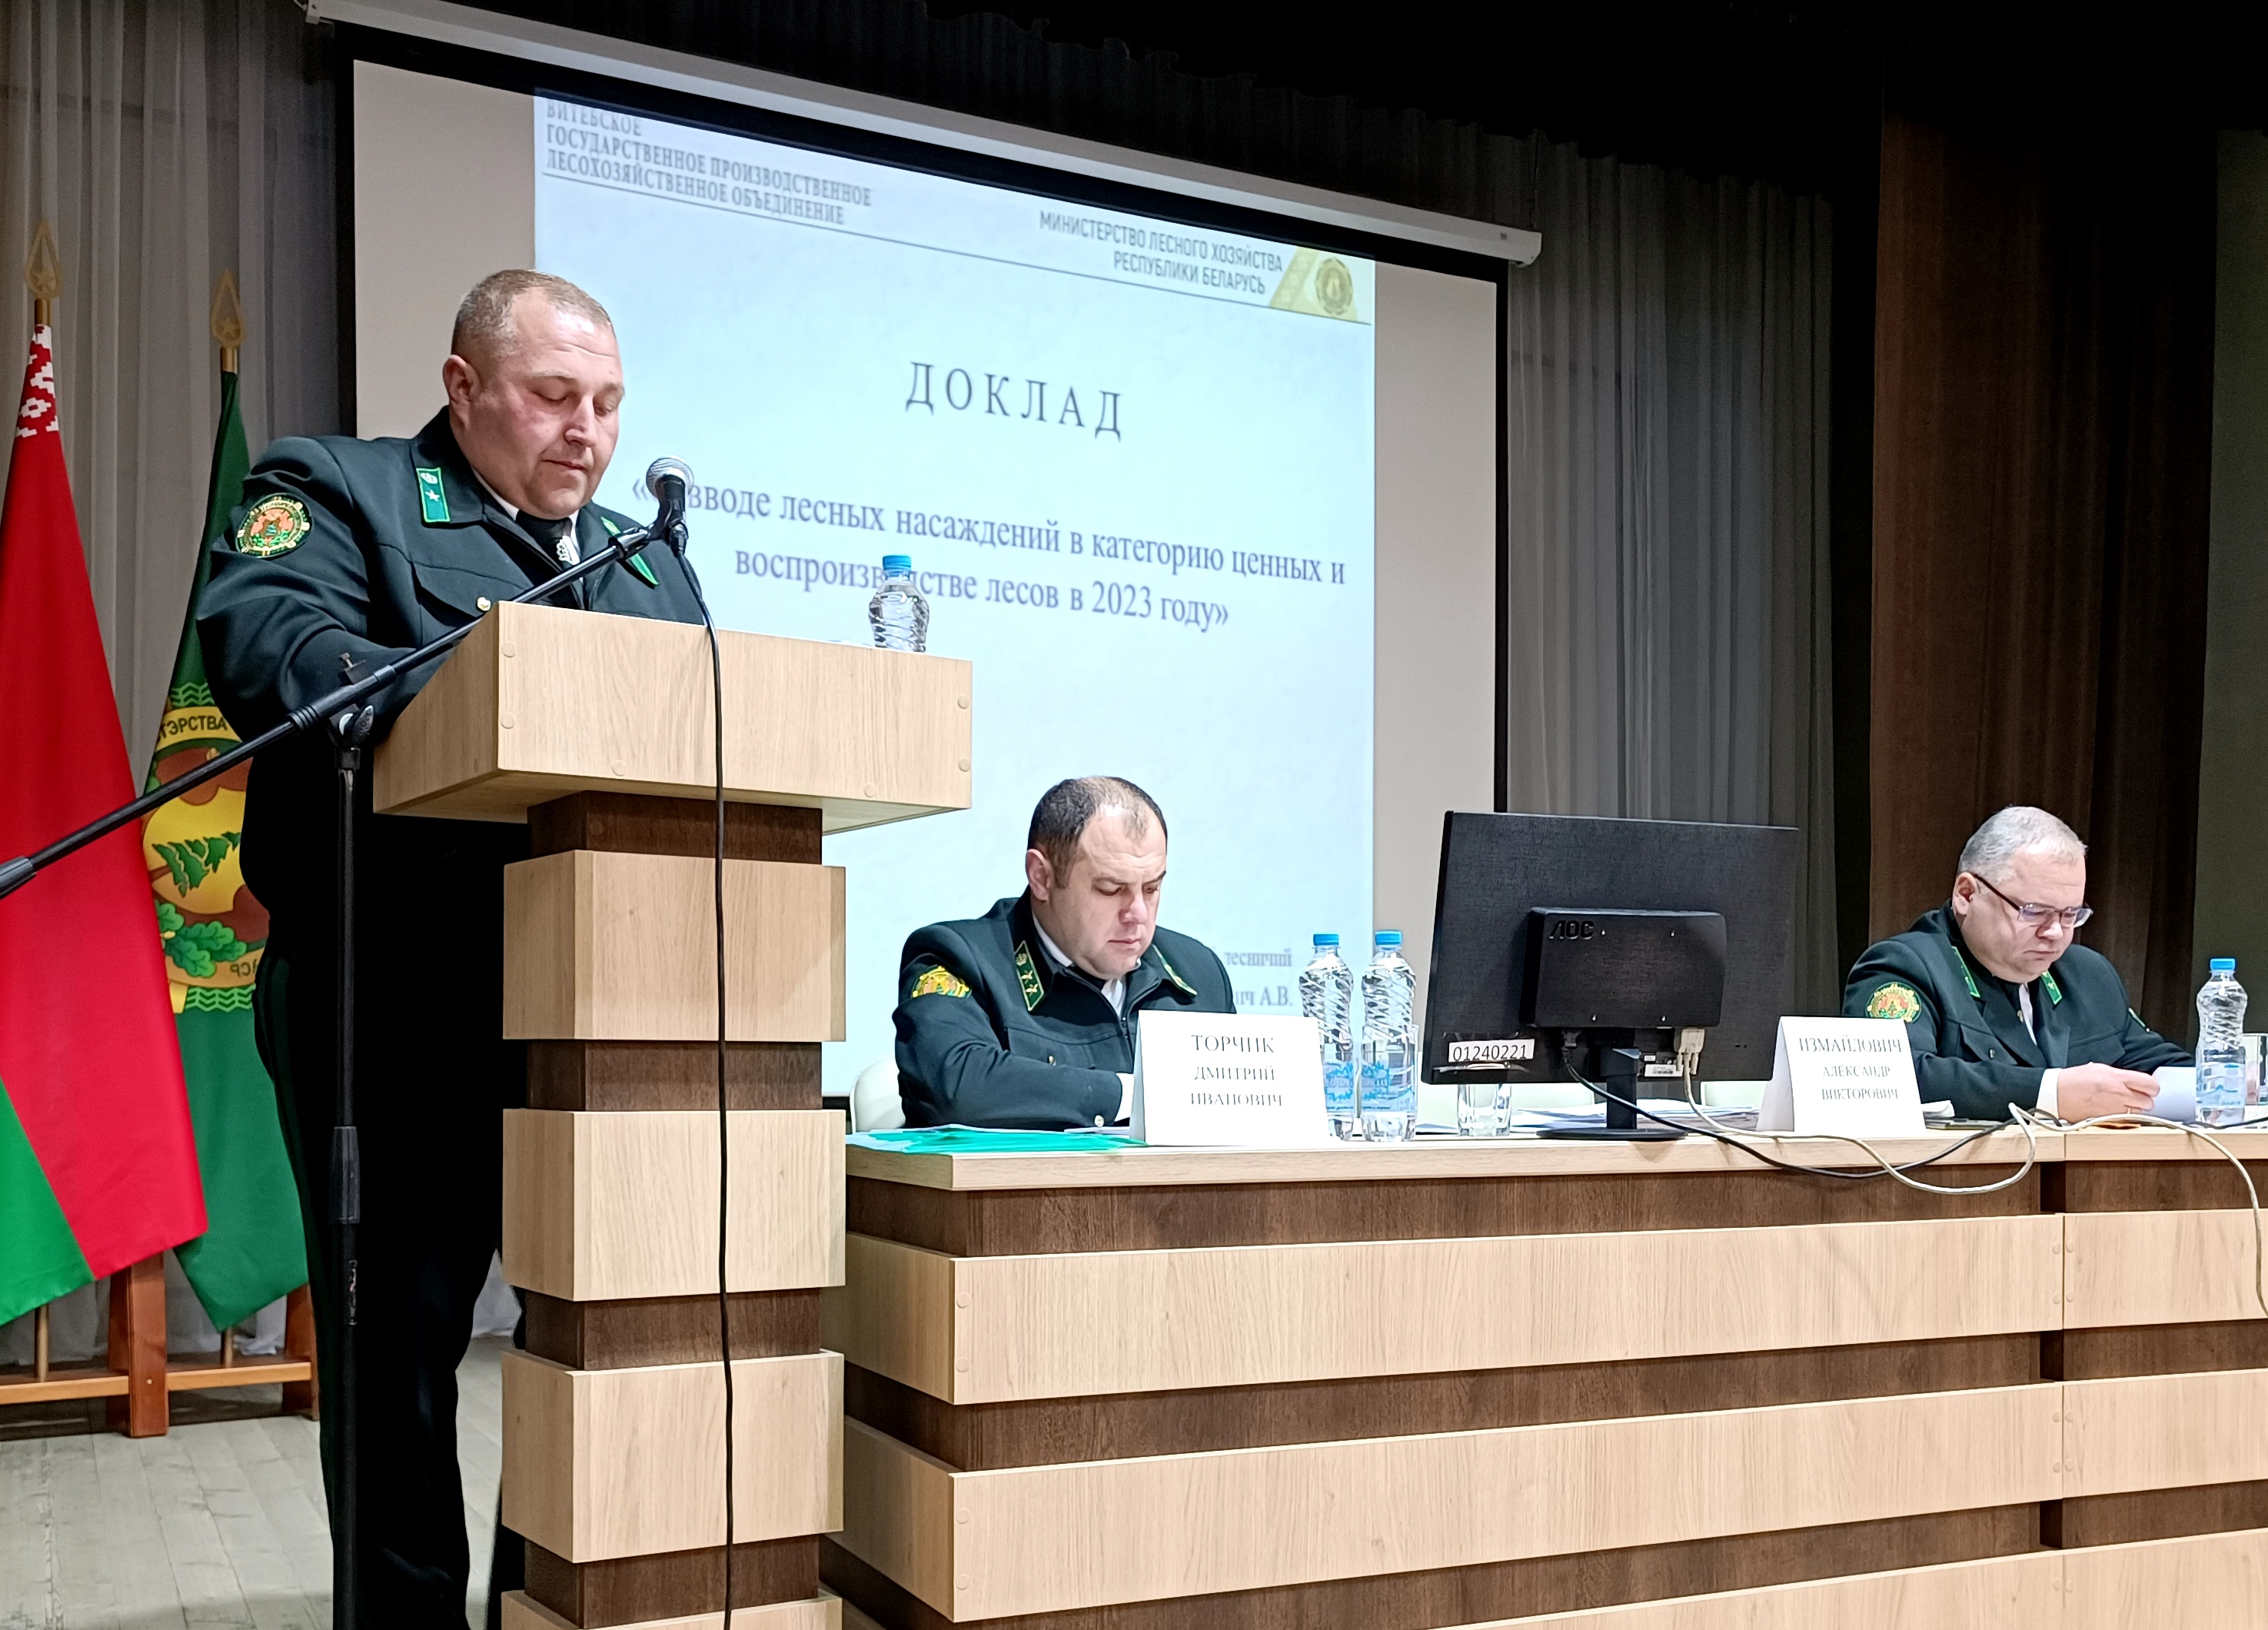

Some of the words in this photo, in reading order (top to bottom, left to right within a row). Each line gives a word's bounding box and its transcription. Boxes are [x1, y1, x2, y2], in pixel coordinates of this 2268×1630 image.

[547, 101, 642, 136] ВИТЕБСКОЕ
[547, 123, 706, 173] ГОСУДАРСТВЕННОЕ
[710, 159, 871, 207] ПРОИЗВОДСТВЕННОЕ
[547, 149, 727, 202] ЛЕСОХОЗЯЙСТВЕННОЕ
[731, 187, 845, 225] ОБЪЕДИНЕНИЕ
[1039, 211, 1146, 248] МИНИСТЕРСТВО
[1149, 231, 1209, 261] ЛЕСНОГО
[1211, 244, 1283, 273] ХОЗЯЙСТВА
[1114, 251, 1199, 284] РЕСПУБЛИКИ
[1202, 266, 1266, 295] БЕЛАРУСЬ
[905, 361, 1122, 444] ДОКЛАД
[687, 484, 770, 521] вводе
[780, 494, 886, 531] лесных
[896, 511, 1060, 553] насаждений
[1069, 531, 1083, 554] в
[1092, 533, 1225, 575] категорию
[1232, 550, 1322, 583] ценных
[1331, 562, 1345, 584] и
[735, 549, 977, 600] воспроизвстве
[985, 577, 1059, 608] лесов
[1069, 587, 1083, 611] в
[1092, 580, 1152, 618] 2023
[1159, 596, 1229, 633] году»
[157, 716, 228, 740] ТЭРСТВА
[1548, 920, 1595, 940] AOC
[1259, 986, 1293, 1006] А.В.
[1191, 1034, 1275, 1053] ТОРЧИК
[1452, 1044, 1527, 1062] 01240221
[1799, 1035, 1901, 1053] ИЗМАЙЛОВИЧ
[1194, 1065, 1275, 1080] ДМИТРИЙ
[1823, 1066, 1891, 1078] АЛЕКСАНДР
[1191, 1093, 1282, 1106] ИВАНОВИЧ
[1821, 1089, 1898, 1100] ВИКТОРОВИЧ
